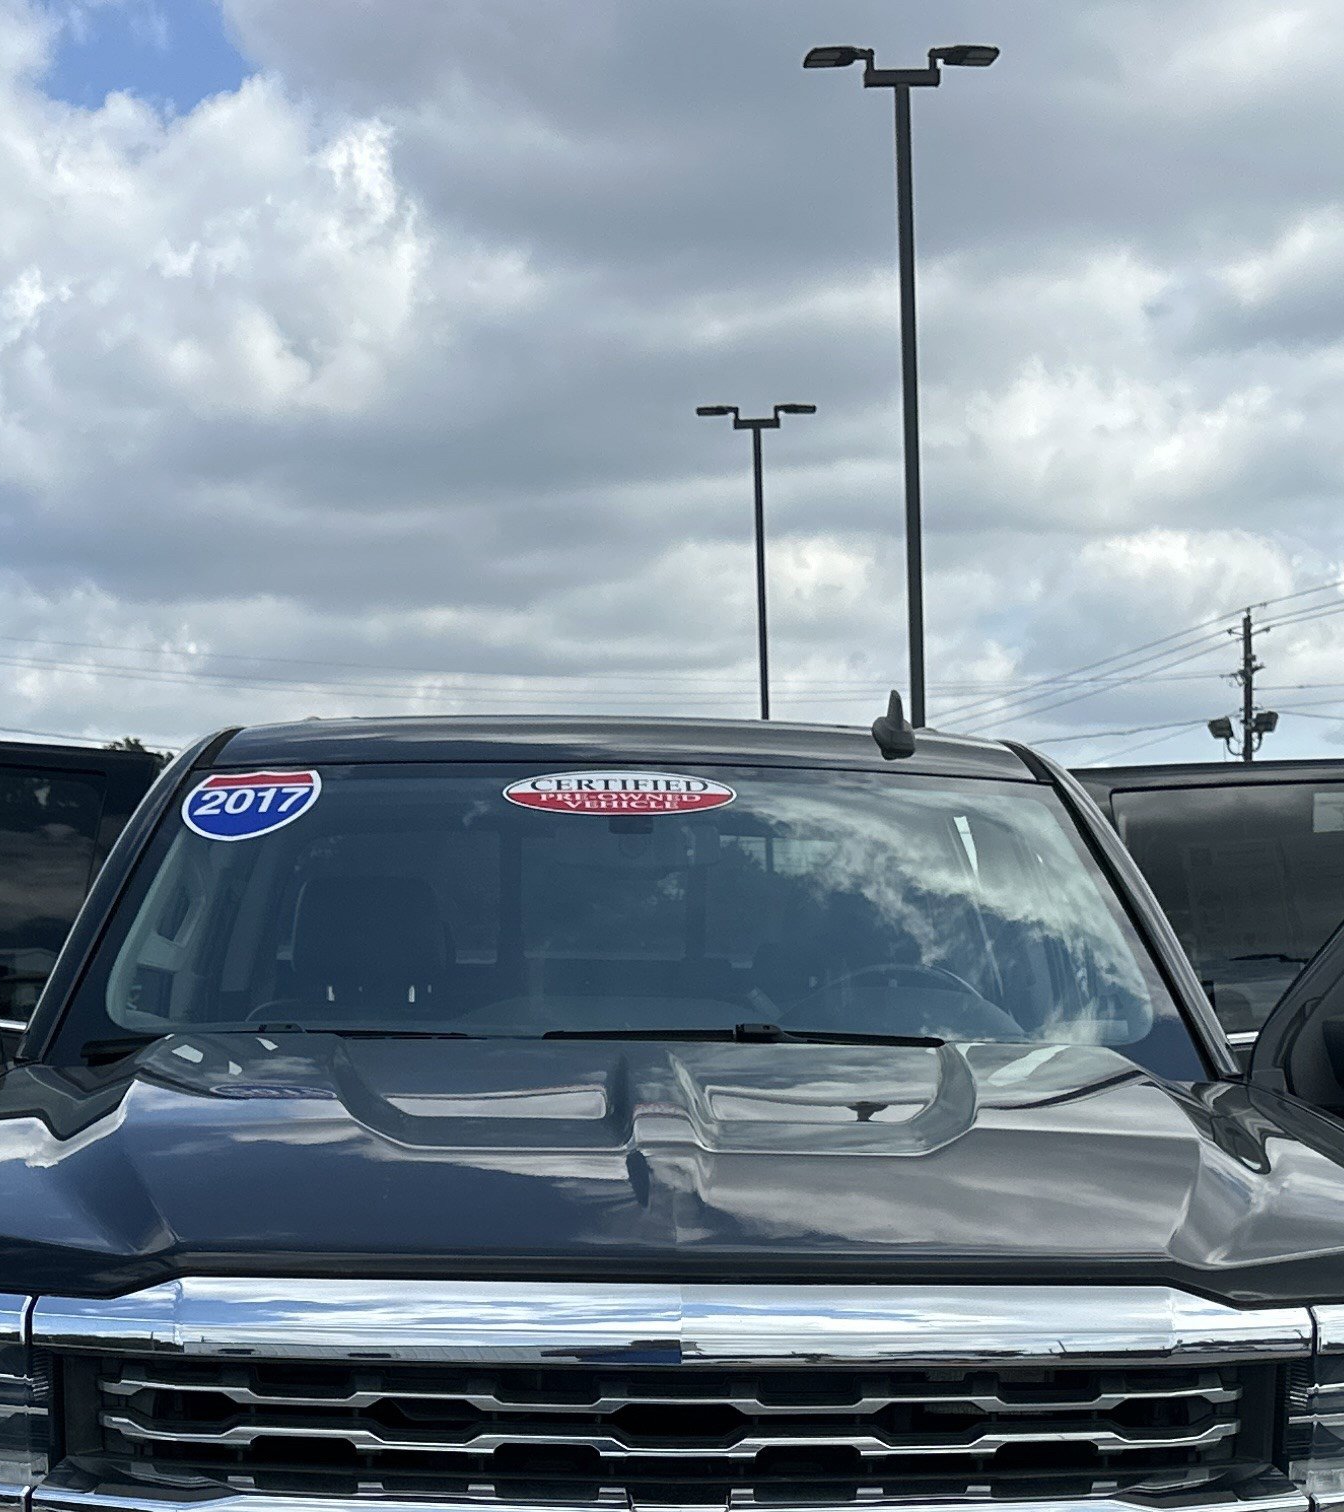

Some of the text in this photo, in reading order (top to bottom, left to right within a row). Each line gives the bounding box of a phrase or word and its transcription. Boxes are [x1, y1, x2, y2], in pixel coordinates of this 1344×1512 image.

[530, 778, 708, 792] CERTIFIED
[193, 787, 310, 816] 2017
[540, 792, 702, 802] PRE-OWNED
[564, 800, 679, 809] VEHICLE
